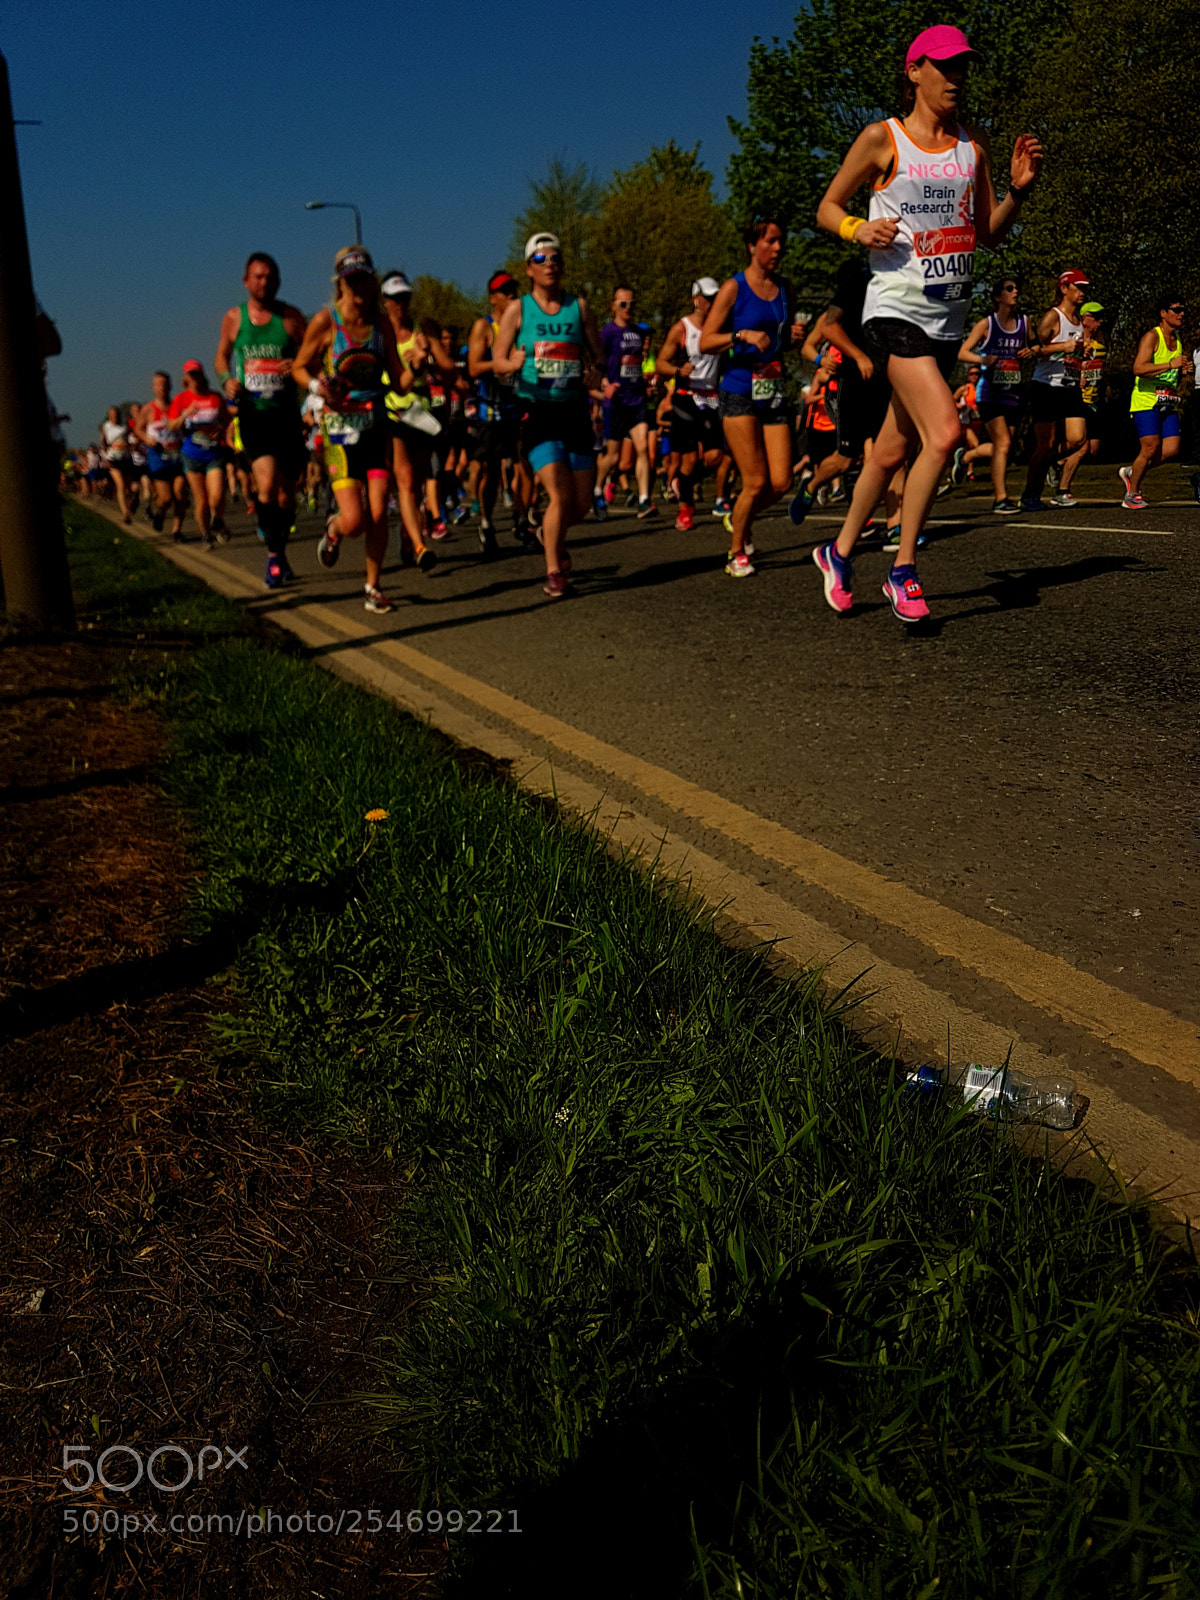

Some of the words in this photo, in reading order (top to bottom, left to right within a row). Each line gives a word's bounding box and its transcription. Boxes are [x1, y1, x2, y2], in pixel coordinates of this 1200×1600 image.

[908, 163, 975, 179] NICOLA
[923, 186, 955, 199] Brain
[900, 201, 954, 216] Research
[939, 214, 954, 227] UK
[918, 231, 943, 255] Virgin
[945, 234, 974, 245] money
[921, 253, 974, 279] 20400
[536, 322, 574, 336] SUZ
